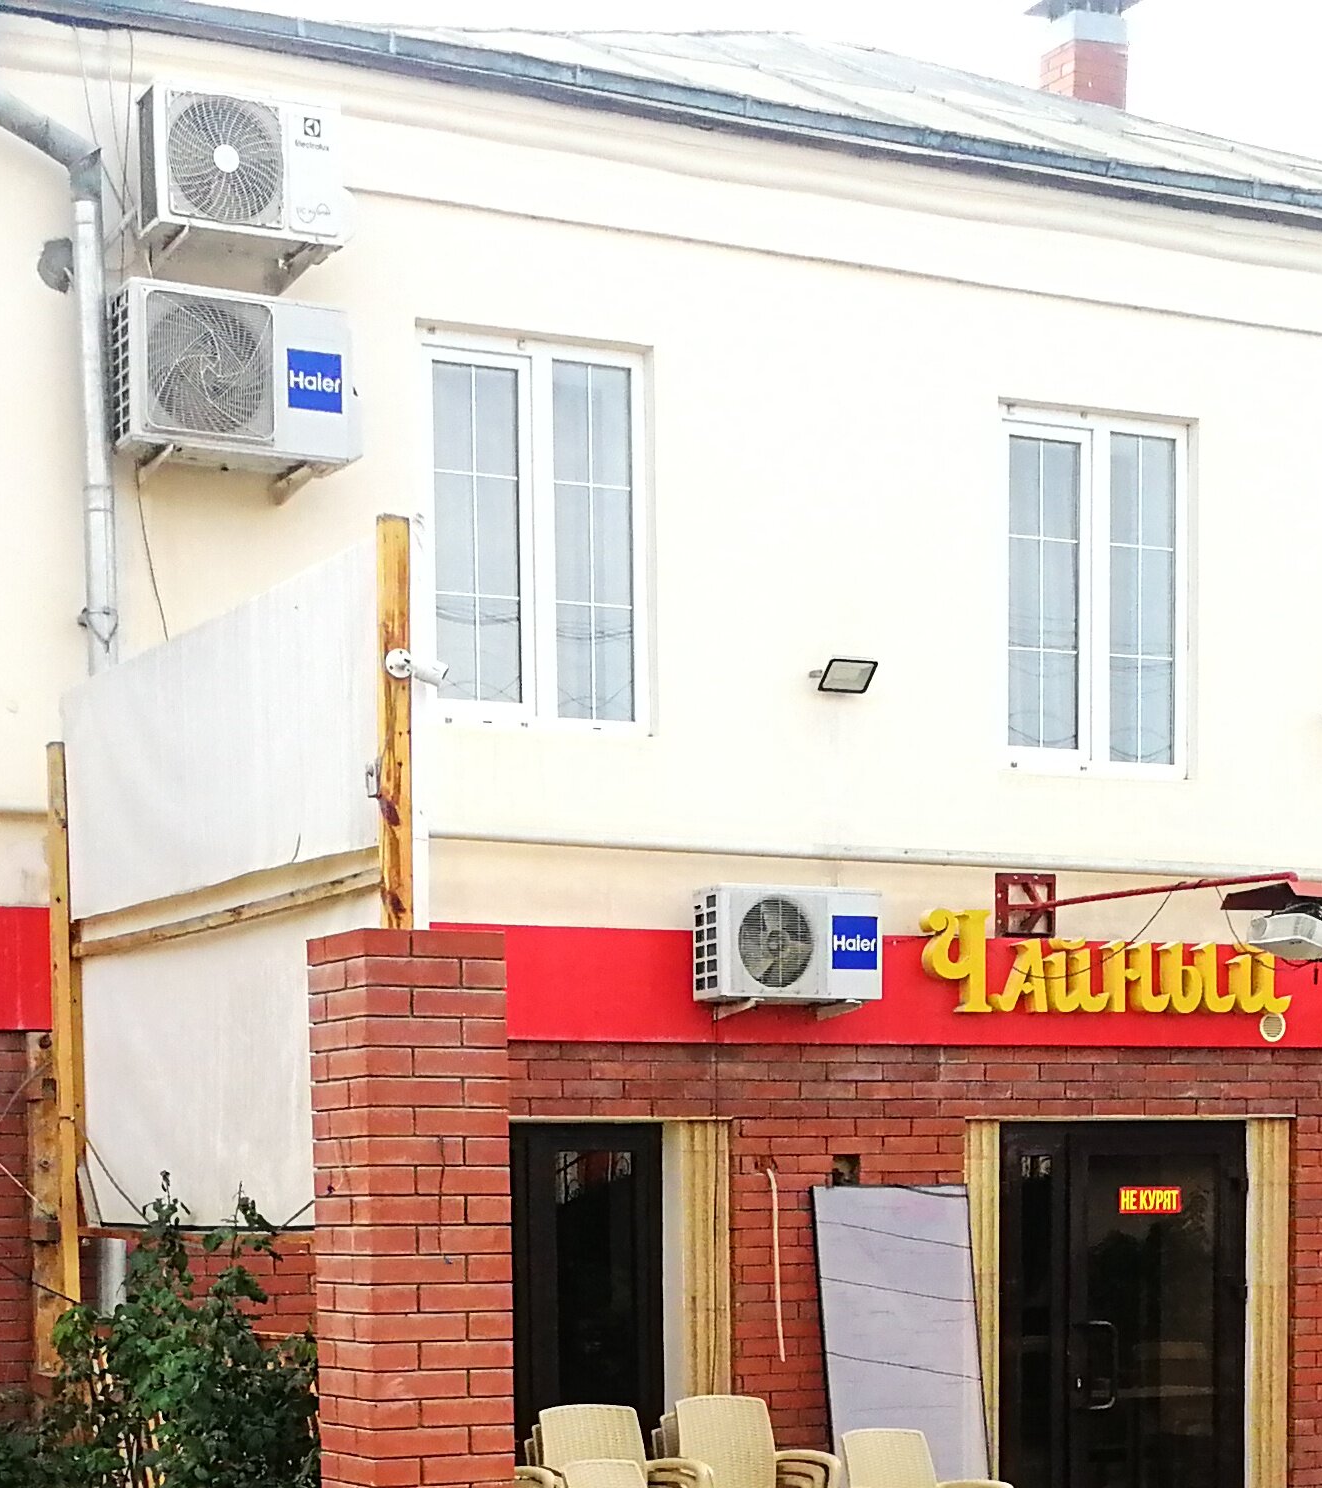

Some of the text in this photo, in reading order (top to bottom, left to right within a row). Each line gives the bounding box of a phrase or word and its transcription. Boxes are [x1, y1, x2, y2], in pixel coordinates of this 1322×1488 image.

[289, 369, 341, 394] Haier
[833, 934, 877, 952] Haier
[920, 908, 1292, 1014] Чайный
[1120, 1189, 1180, 1210] НЕ КУРЯТ
